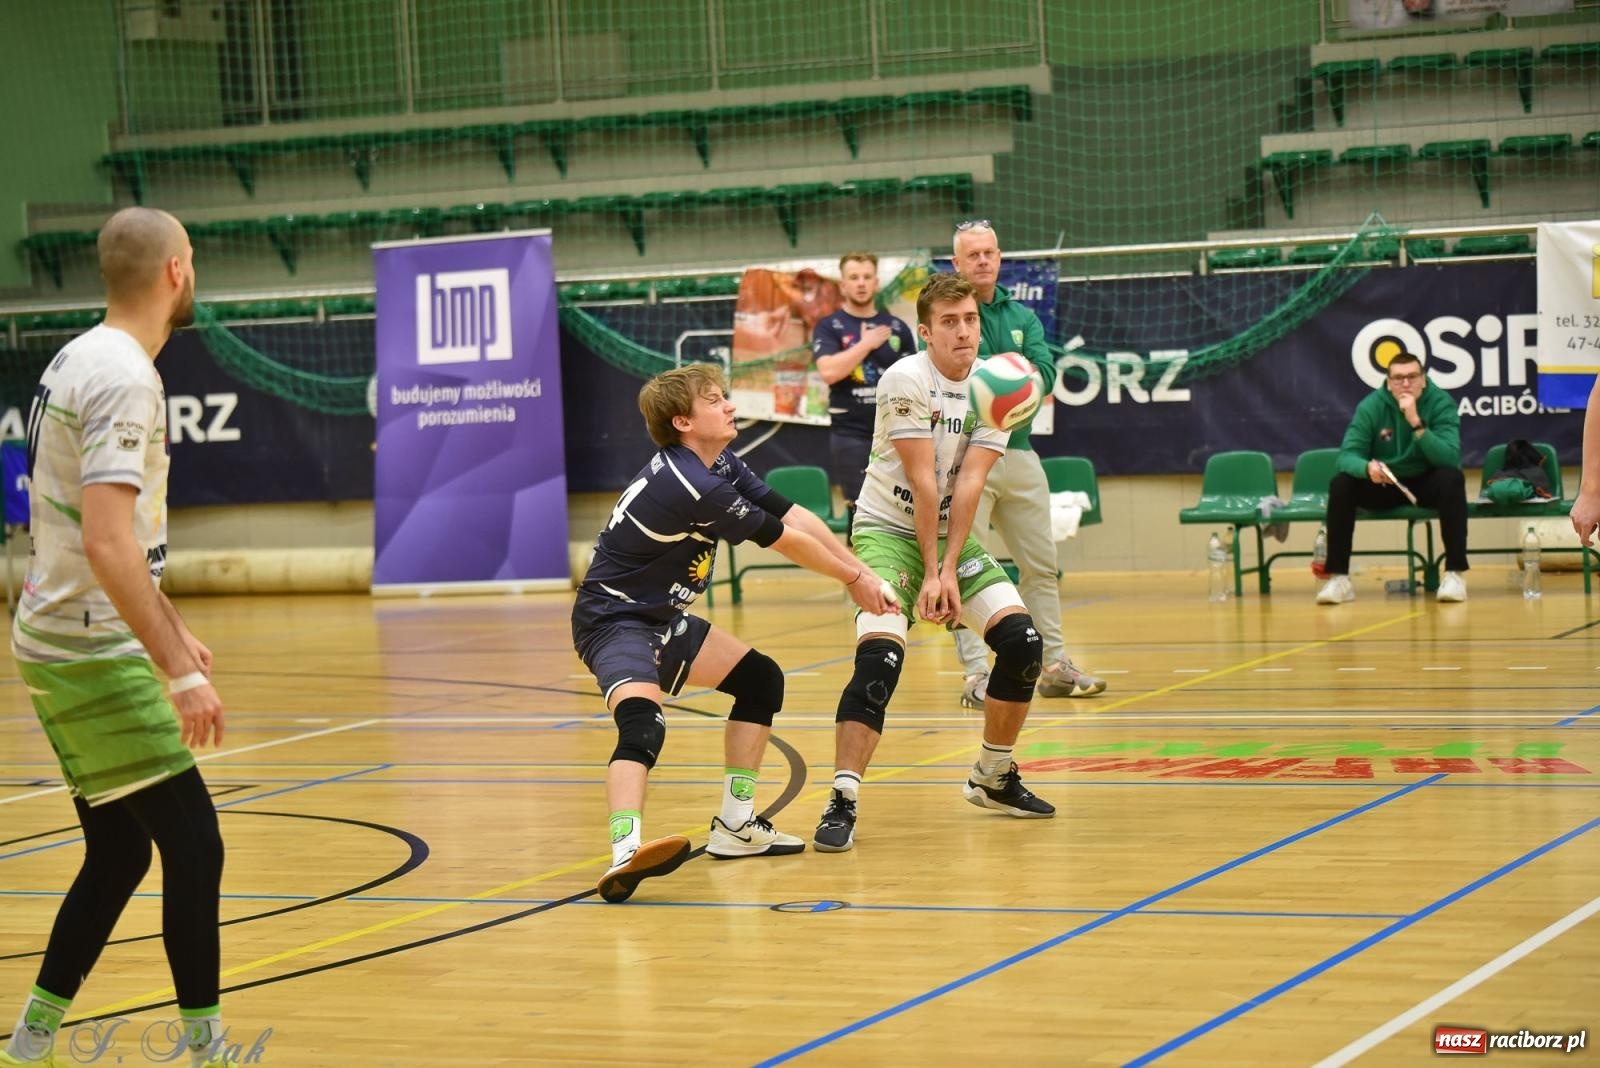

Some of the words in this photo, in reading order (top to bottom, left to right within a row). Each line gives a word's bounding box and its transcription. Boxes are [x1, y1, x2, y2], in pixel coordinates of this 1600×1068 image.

[422, 269, 506, 364] bmp
[1556, 314, 1579, 328] tel.
[390, 384, 461, 407] budujemy
[463, 378, 542, 400] możliwości
[1457, 388, 1571, 418] ACIBÓ
[417, 404, 517, 431] porozumienia
[946, 417, 962, 435] 10
[608, 477, 649, 531] 4
[893, 485, 915, 504] PO
